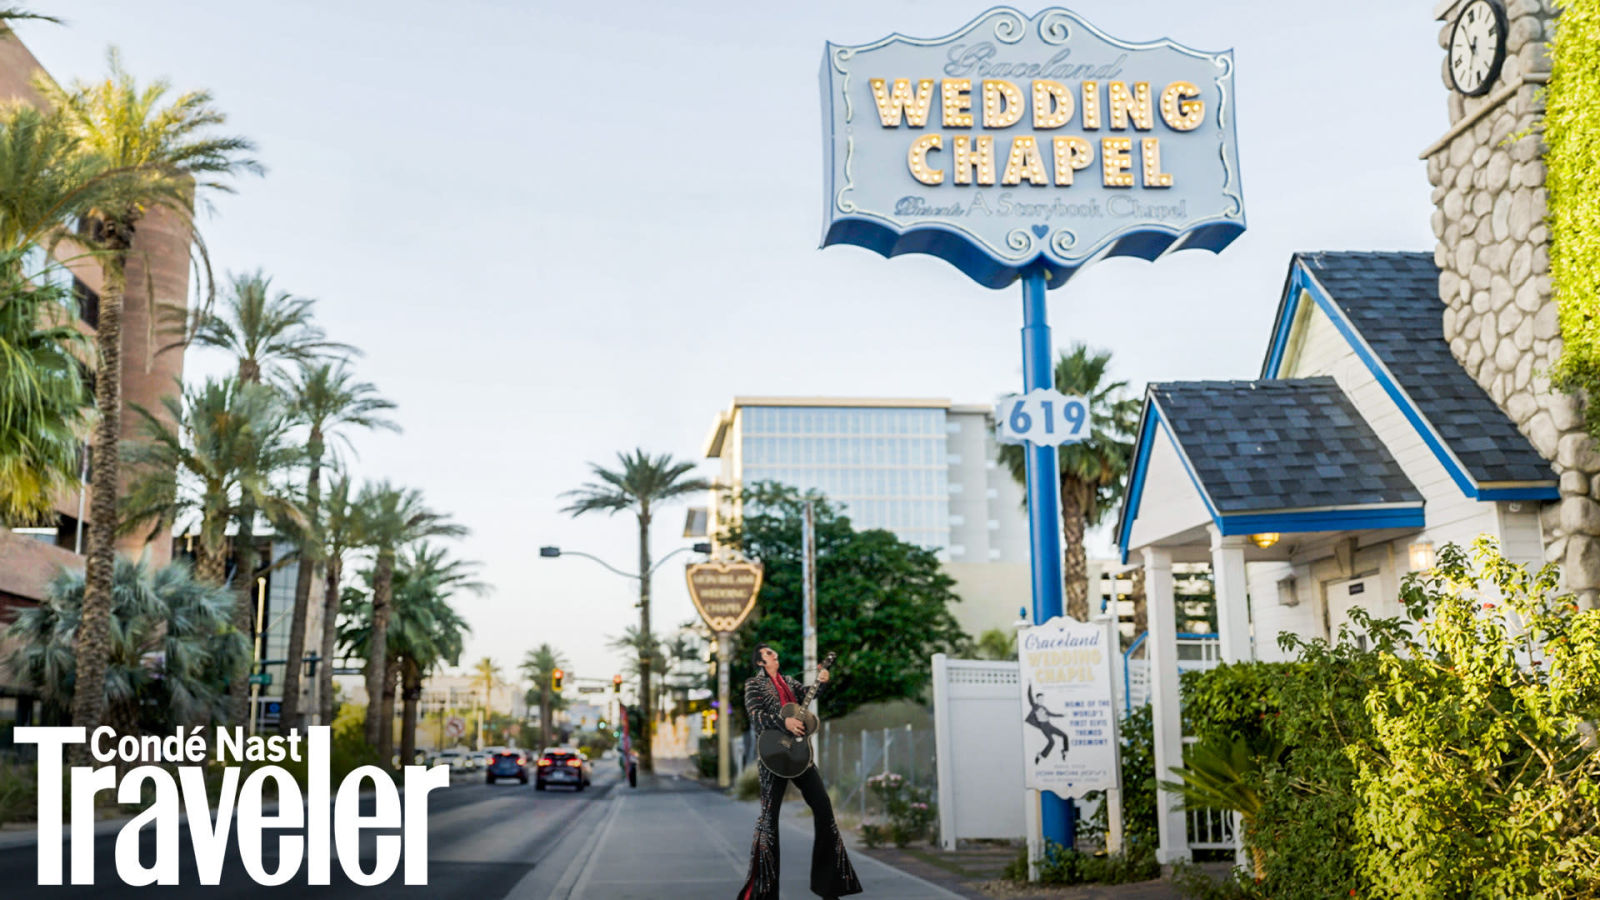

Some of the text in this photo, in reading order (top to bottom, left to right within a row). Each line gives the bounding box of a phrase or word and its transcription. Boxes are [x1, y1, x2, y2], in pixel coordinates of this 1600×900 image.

[943, 41, 1128, 80] Graceland
[868, 78, 1206, 131] WEDDING
[907, 134, 1173, 188] CHAPEL
[966, 191, 992, 217] A
[1106, 194, 1187, 220] Chapel
[1009, 400, 1086, 435] 619
[1025, 631, 1100, 650] Graceland
[1027, 650, 1103, 668] WEDDING
[1035, 666, 1095, 684] CHAPEL
